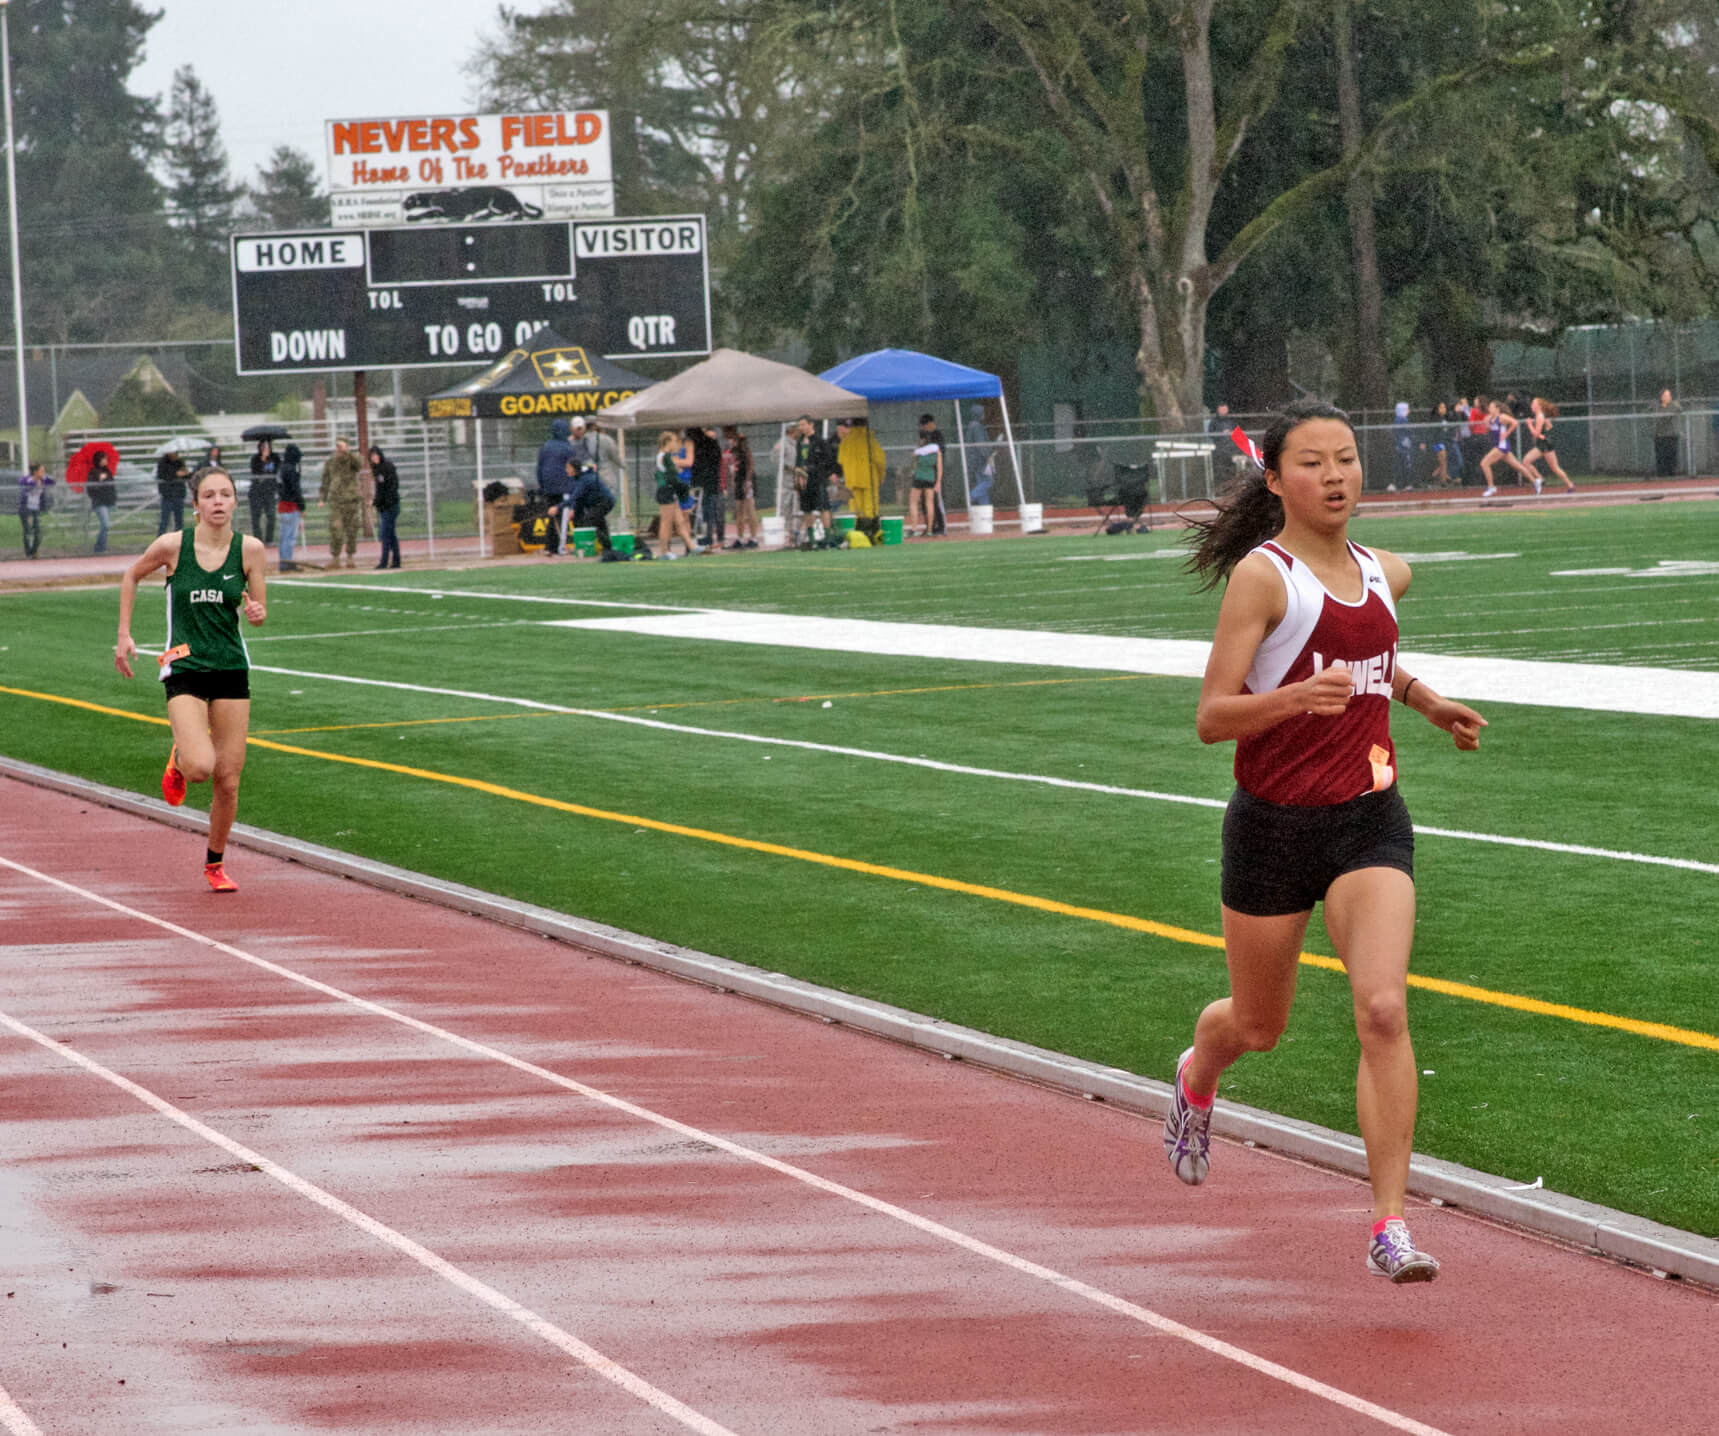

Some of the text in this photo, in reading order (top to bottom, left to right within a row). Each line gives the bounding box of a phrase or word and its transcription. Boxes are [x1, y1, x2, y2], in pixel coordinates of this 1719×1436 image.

[333, 113, 603, 154] NEVERS FIELD
[353, 154, 589, 185] Home Of The Panthers
[256, 241, 346, 266] HOME
[581, 227, 696, 253] VISITOR
[368, 291, 404, 309] TOL
[542, 284, 577, 301] TOL
[271, 329, 346, 362] DOWN
[424, 320, 549, 355] TO GO O
[628, 315, 676, 350] QTR
[190, 590, 223, 604] CASA
